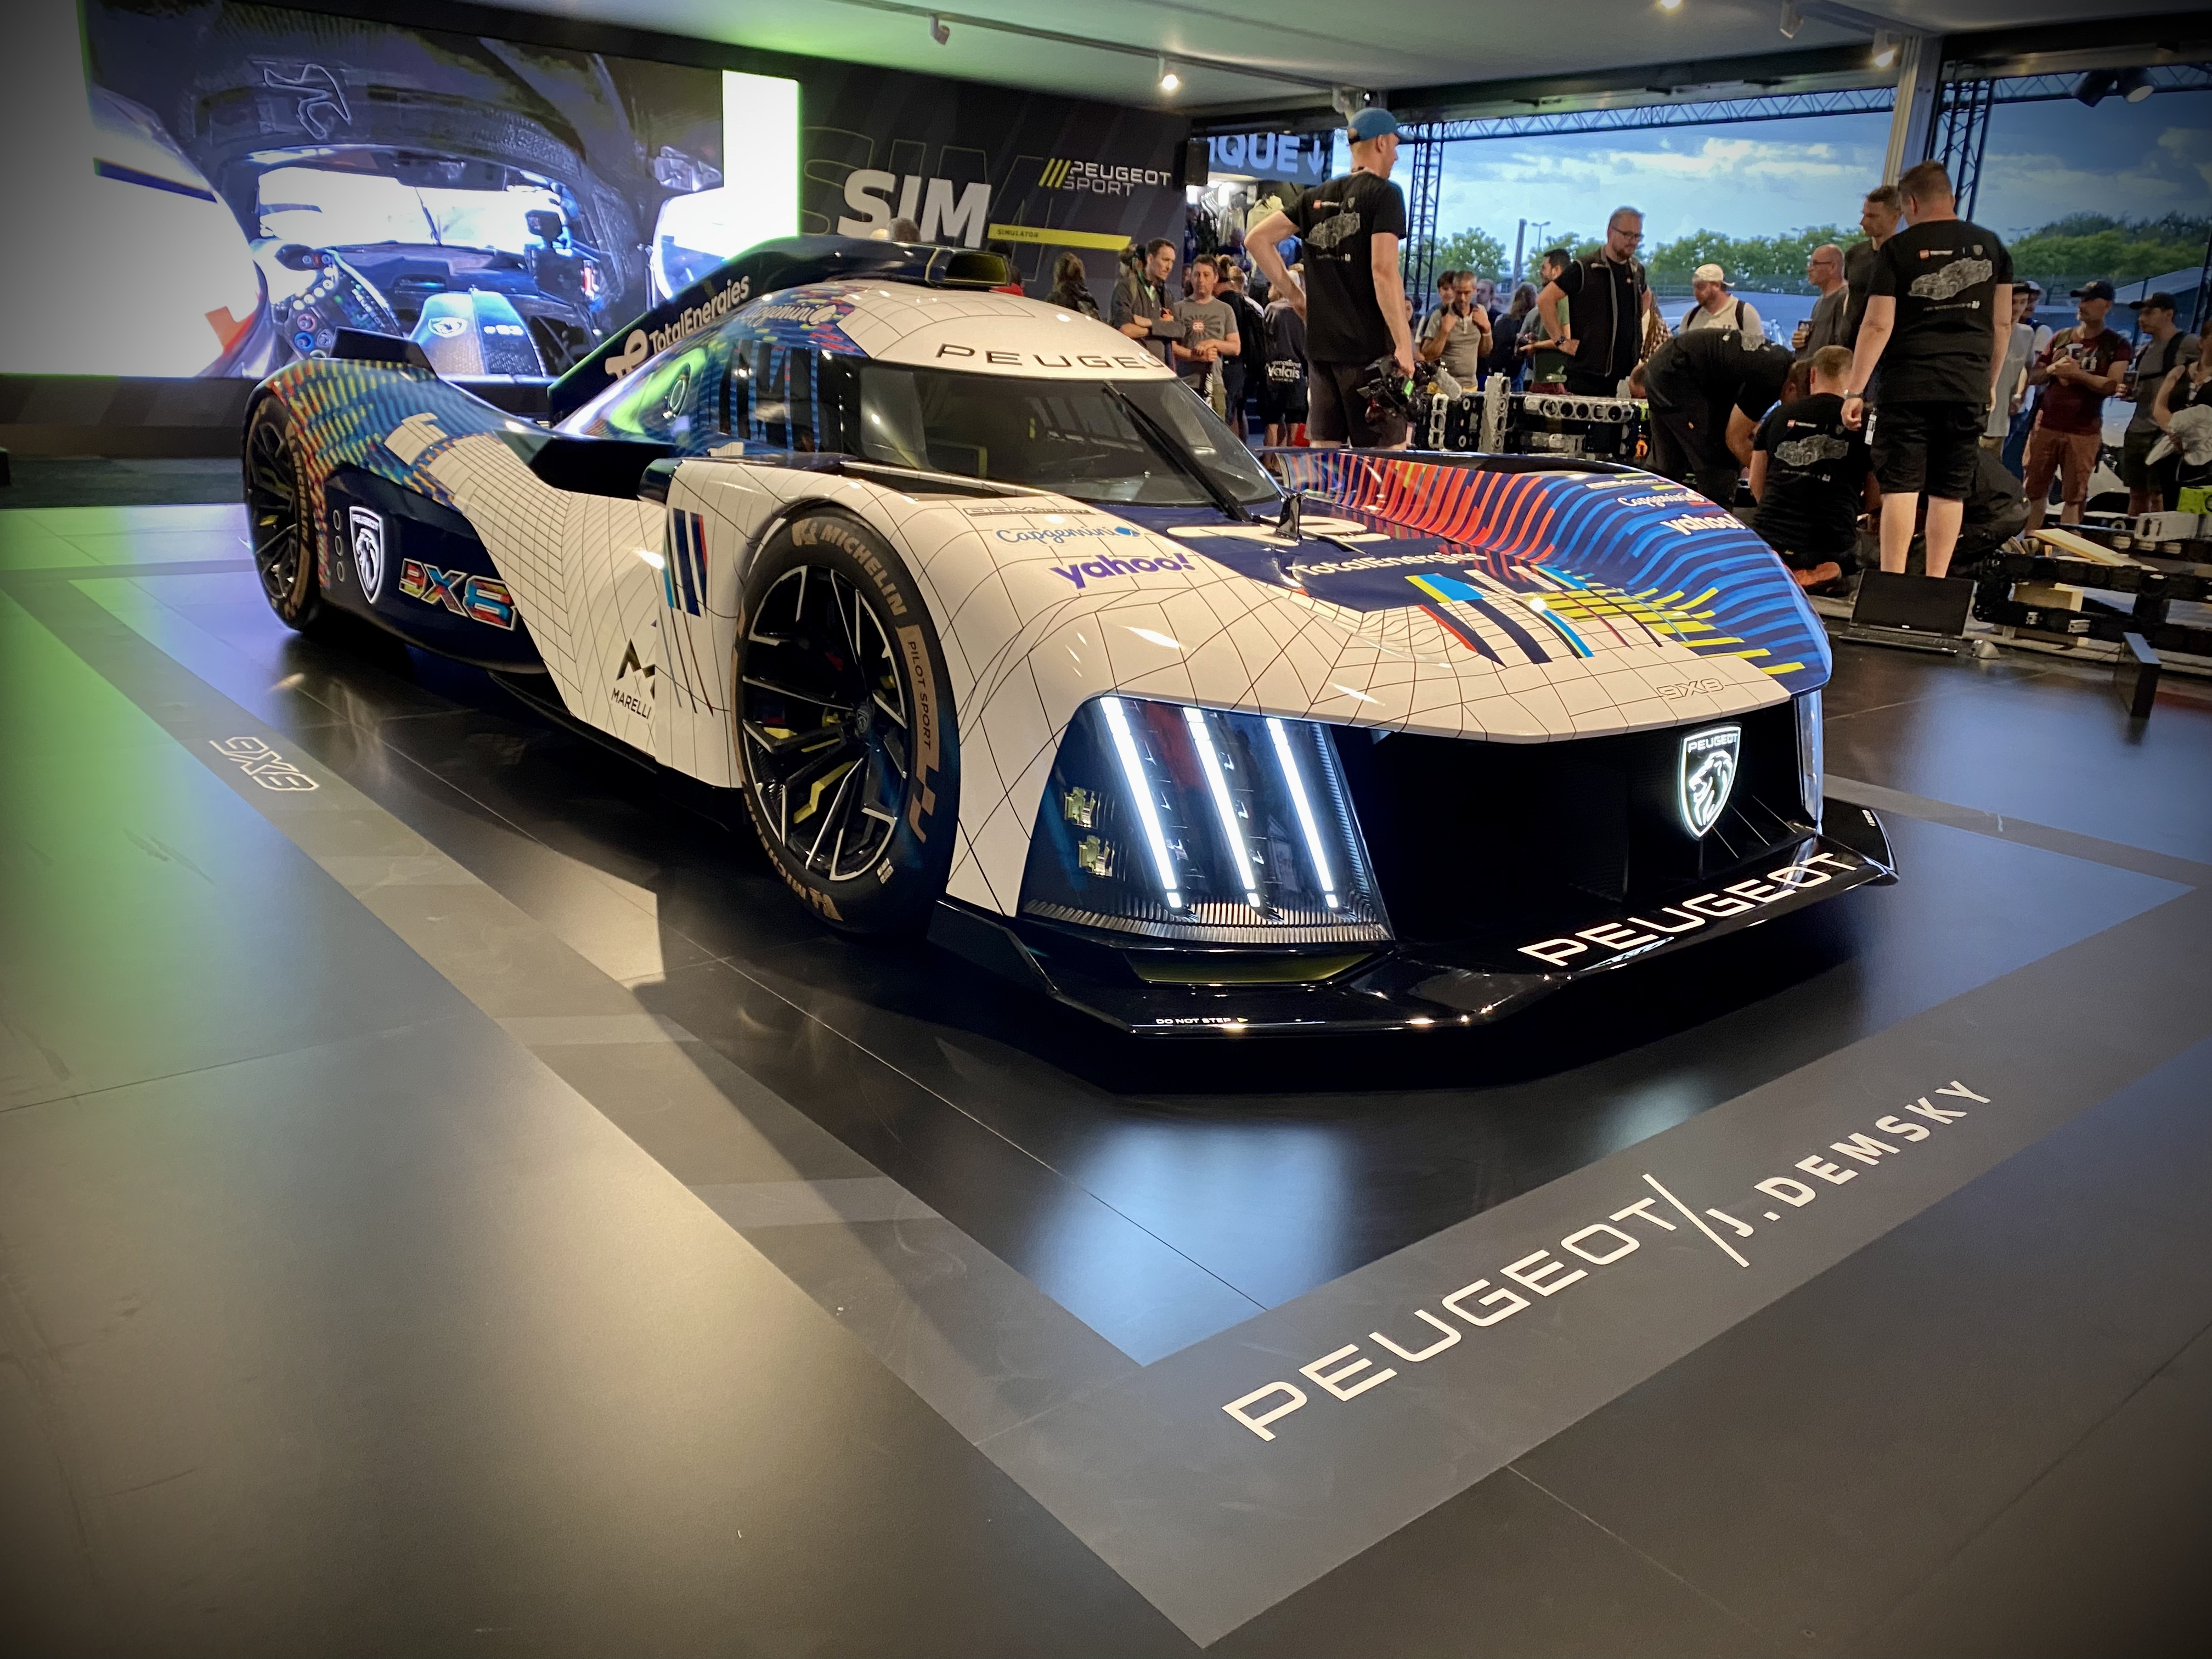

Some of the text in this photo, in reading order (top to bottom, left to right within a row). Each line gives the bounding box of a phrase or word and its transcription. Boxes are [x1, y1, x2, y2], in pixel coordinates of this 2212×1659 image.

[1207, 132, 1300, 173] IQUE
[1063, 176, 1135, 196] SPORT
[1070, 161, 1172, 185] PEUGEOT
[837, 169, 991, 248] SIM
[996, 228, 1039, 238] SIMULATOR
[648, 275, 751, 356] TotalEnergies
[1268, 364, 1300, 379] Valais
[996, 526, 1118, 544] Capgemini
[1660, 513, 1746, 535] yahoo!
[820, 524, 907, 616] MICHELIN
[1048, 553, 1197, 589] yahoo!
[1285, 551, 1487, 575] TotalEnergies
[611, 687, 652, 720] MARELLI
[907, 640, 933, 751] PILOT SPORT
[1656, 678, 1724, 701] 9X8
[1688, 732, 1739, 753] PEUGEOT
[208, 736, 320, 791] 9X8
[1517, 851, 1858, 967] PEUGEOT
